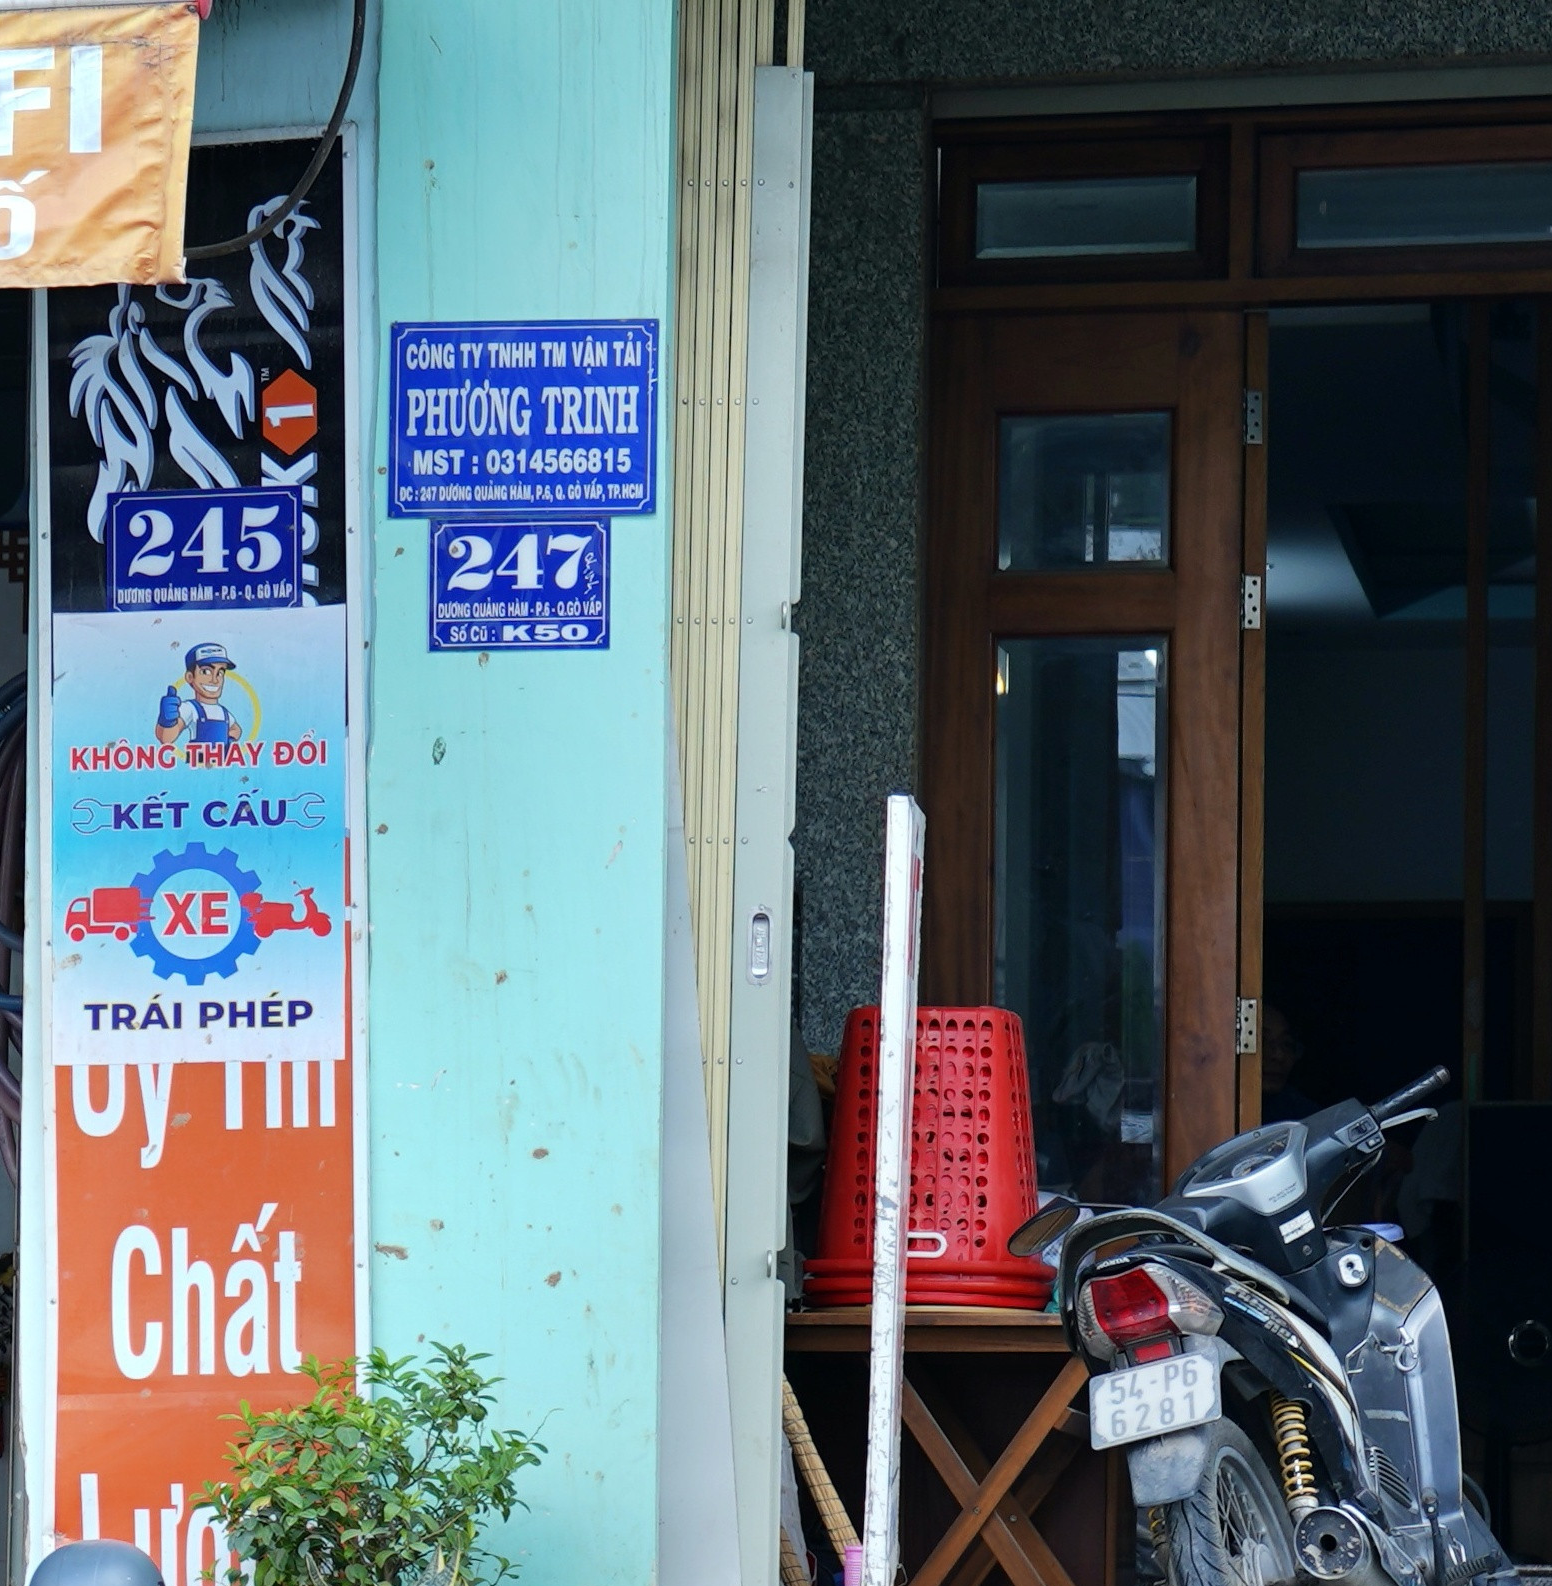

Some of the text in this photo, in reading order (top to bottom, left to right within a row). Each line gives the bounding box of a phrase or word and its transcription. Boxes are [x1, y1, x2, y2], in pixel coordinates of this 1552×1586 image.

[406, 331, 642, 375] CÔNG TY TNHH TM VẬN TẢI
[406, 378, 640, 437] PHƯƠNG TRINH
[413, 449, 465, 476] MST
[485, 448, 631, 475] 0314566815
[420, 486, 436, 502] 247
[567, 480, 581, 501] GÒ
[607, 484, 644, 500] TP.HCM
[128, 505, 282, 577] 245
[447, 533, 592, 591] 247
[154, 583, 188, 604] QUẢNG
[190, 583, 213, 600] HÀM
[221, 585, 236, 600] P.6
[245, 584, 255, 600] Q.
[257, 580, 271, 599] GÒ
[273, 578, 293, 599] VẤP
[472, 597, 505, 619] QUẢNG
[508, 597, 528, 617] HÀM
[536, 601, 550, 616] P.6
[582, 594, 602, 615] VẤP
[450, 623, 468, 643] Số
[470, 625, 487, 641] Cũ
[502, 624, 589, 641] K50
[70, 730, 327, 772] KHÔNG THAY ĐỔI
[112, 789, 287, 831] KẾT CẤU
[162, 892, 230, 936] XE
[84, 992, 314, 1031] TRÁI PHÉP
[111, 1202, 302, 1379] Chất
[1111, 1391, 1195, 1437] 6281
